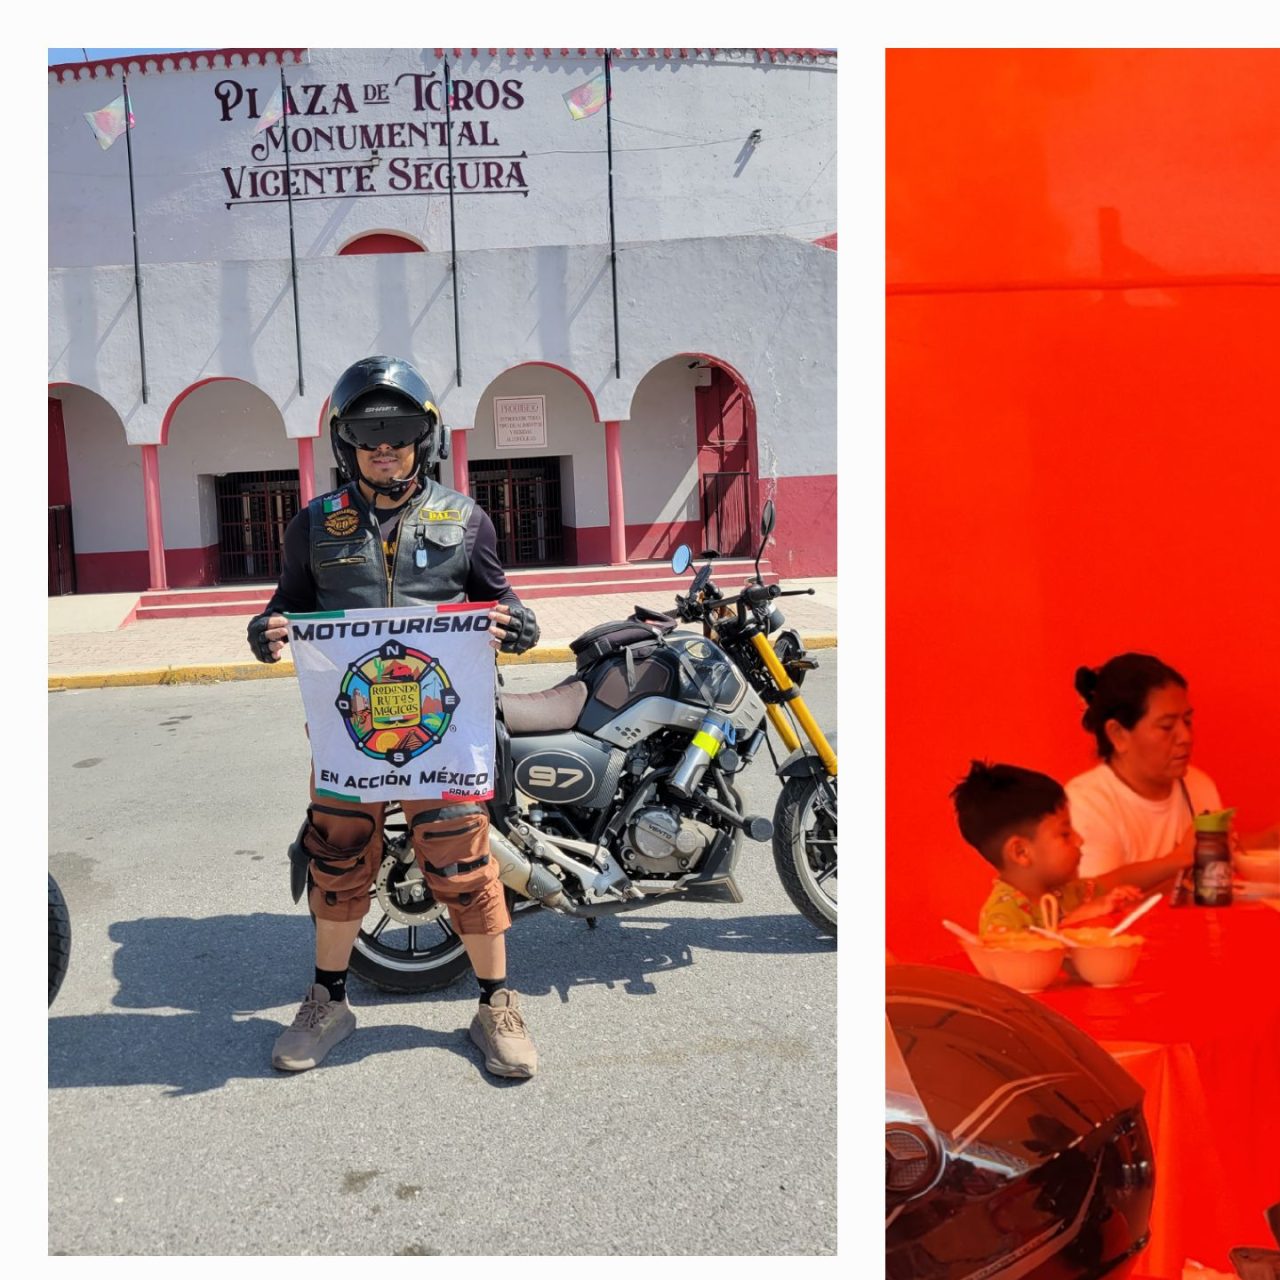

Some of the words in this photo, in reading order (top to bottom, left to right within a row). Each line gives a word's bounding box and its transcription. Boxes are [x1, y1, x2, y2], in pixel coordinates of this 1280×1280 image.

[363, 83, 390, 102] DE
[395, 71, 525, 112] TOROS
[251, 120, 500, 161] MONUMENTAL
[221, 165, 377, 199] VICENTE
[388, 157, 529, 190] SEGURA
[292, 615, 491, 641] MOTOTURISMO
[386, 645, 400, 656] N
[444, 695, 456, 705] E
[393, 752, 405, 762] S
[320, 769, 339, 785] EN
[344, 770, 412, 789] ACCIÓN
[420, 766, 489, 787] MÉXICO
[528, 765, 584, 789] 97
